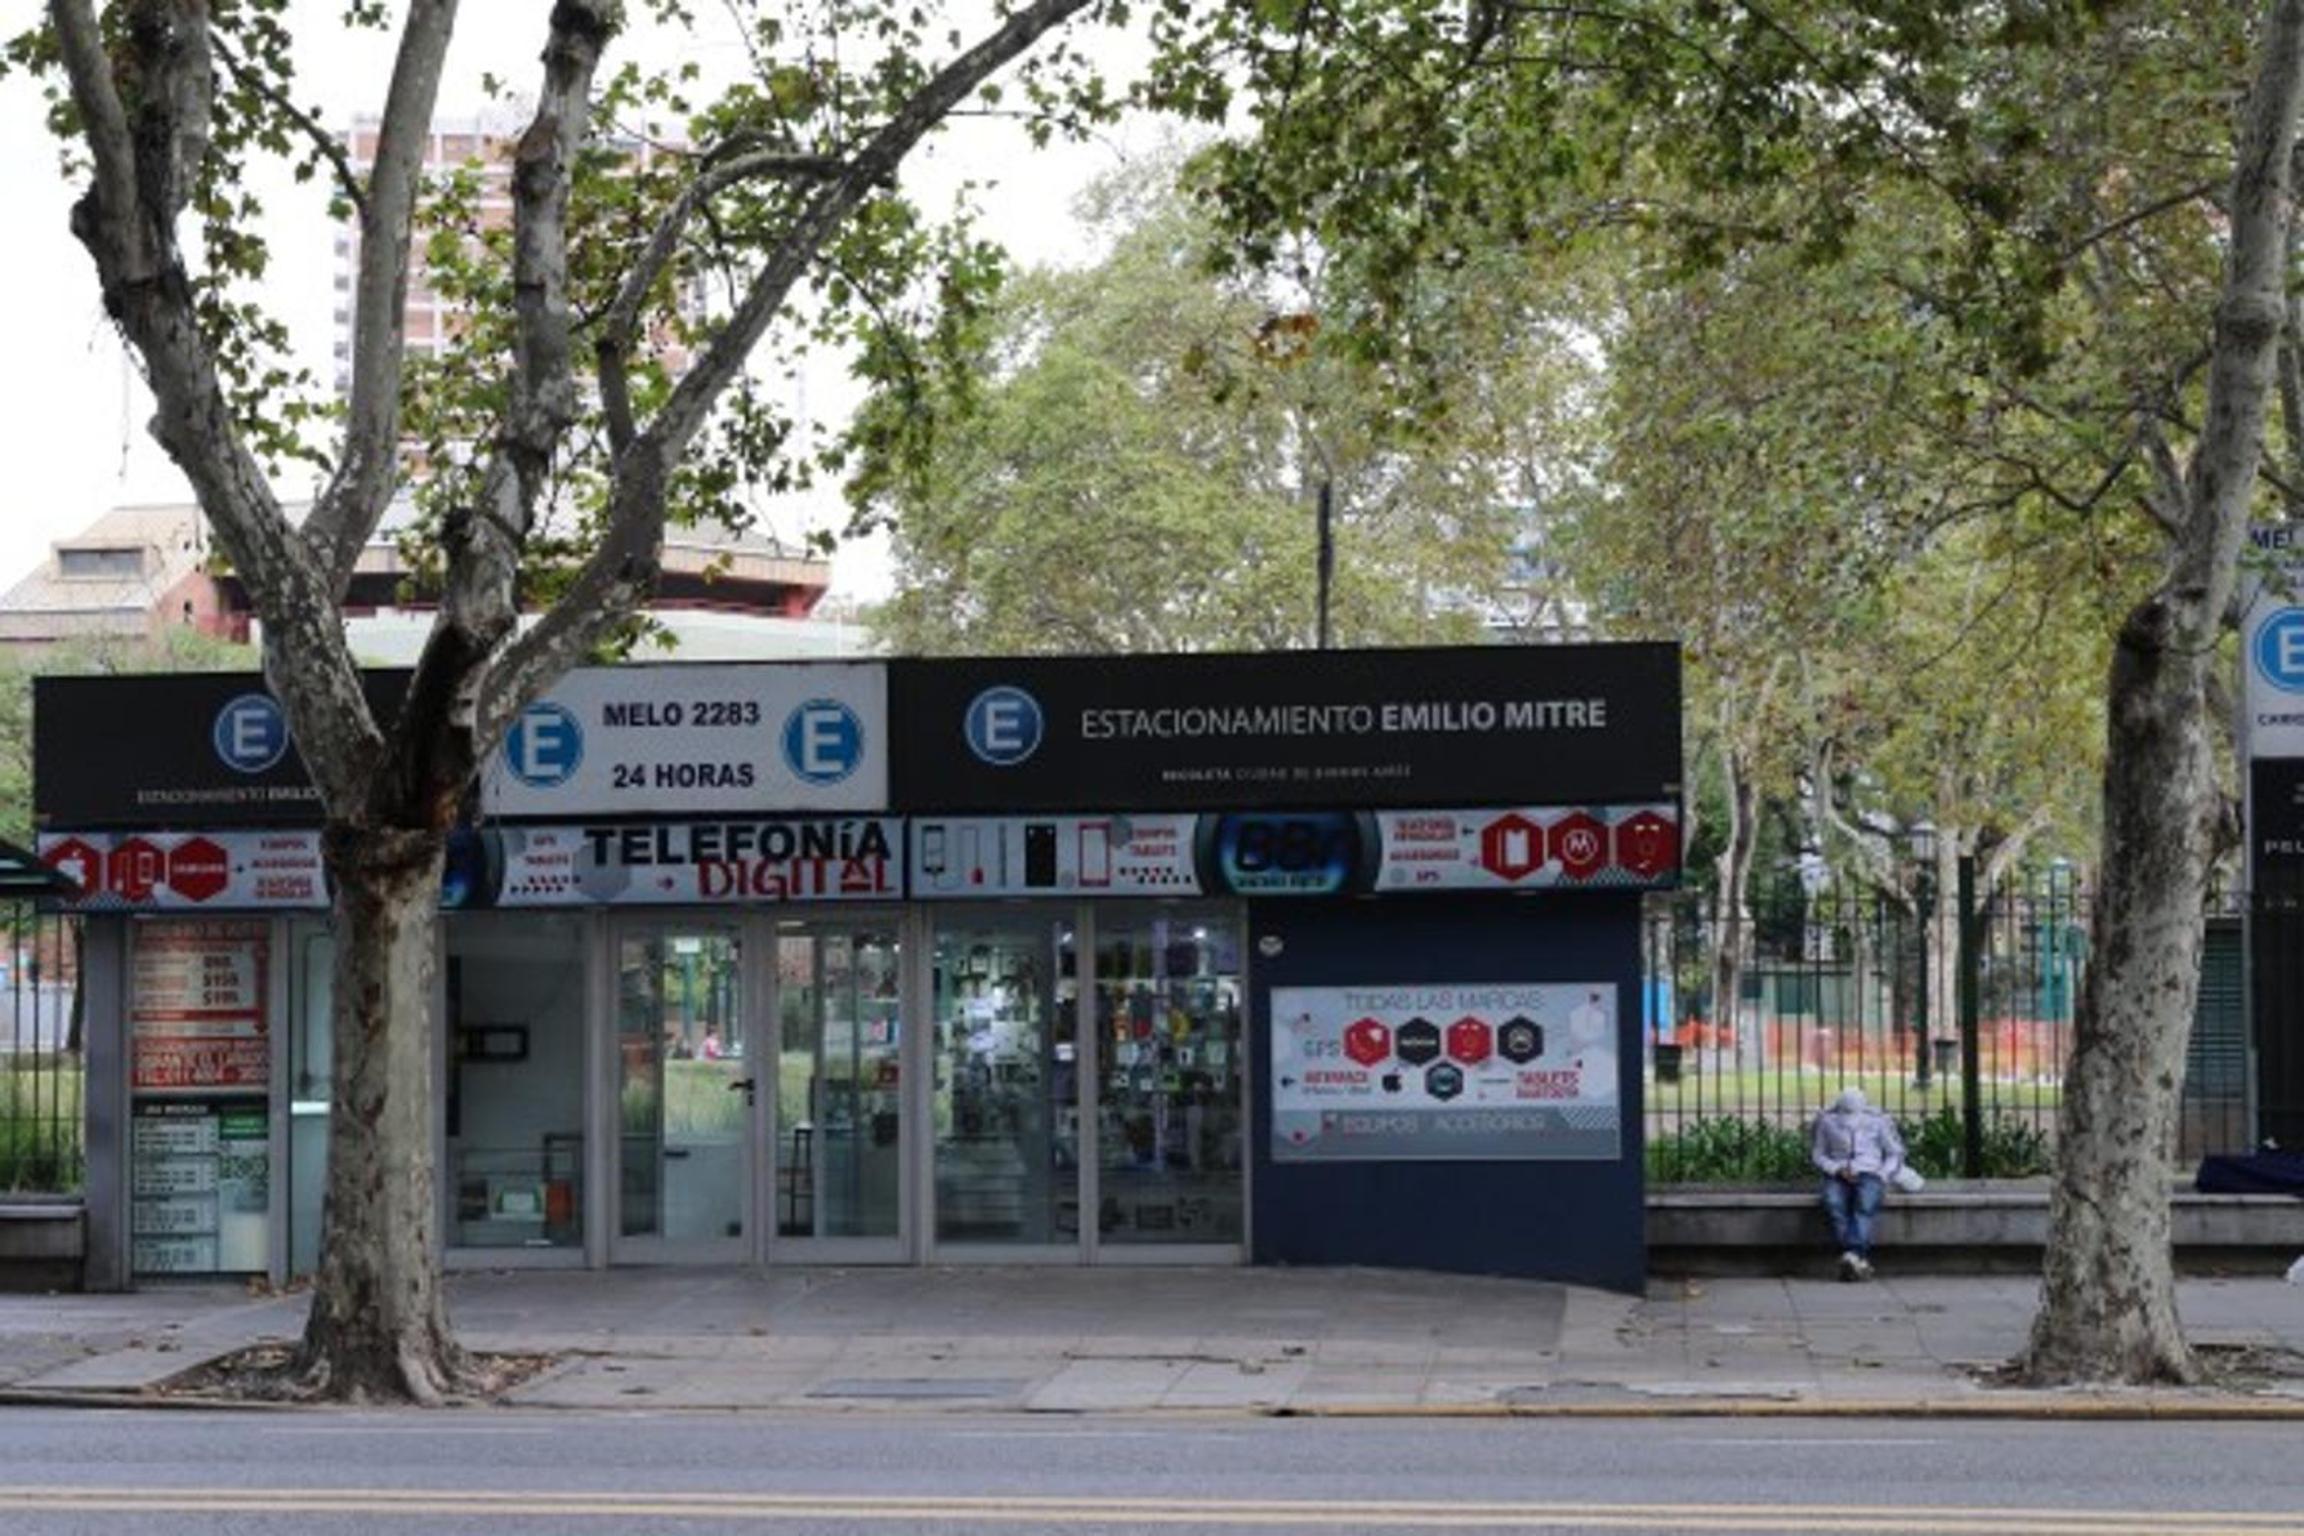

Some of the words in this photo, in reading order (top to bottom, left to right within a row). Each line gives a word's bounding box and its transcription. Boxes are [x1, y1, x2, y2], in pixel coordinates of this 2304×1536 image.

[233, 709, 270, 758] E
[603, 703, 683, 728] MELO
[690, 702, 761, 726] 2283
[983, 700, 1022, 750] E
[1081, 704, 1373, 740] ESTACIONAMIENTO
[1381, 703, 1496, 733] EMILIO
[1504, 699, 1607, 729] MITRE
[521, 713, 564, 779] E
[801, 709, 845, 774] E
[612, 765, 646, 789] 24
[655, 763, 755, 788] HORAS
[697, 858, 895, 898] DIGITAL
[1345, 991, 1411, 1012] TODAS
[1416, 990, 1453, 1011] LAS
[1459, 989, 1544, 1010] MARCAS
